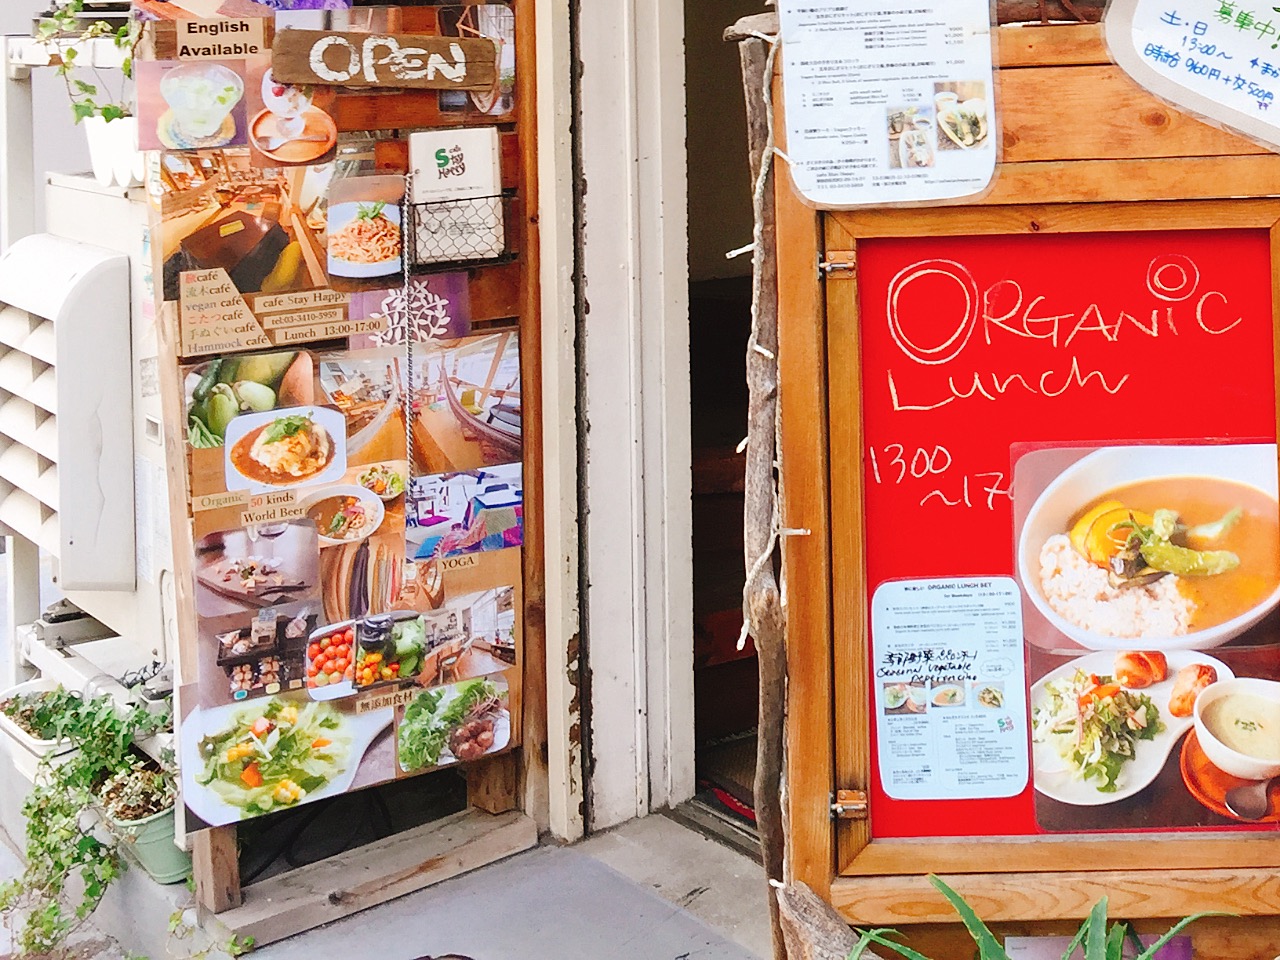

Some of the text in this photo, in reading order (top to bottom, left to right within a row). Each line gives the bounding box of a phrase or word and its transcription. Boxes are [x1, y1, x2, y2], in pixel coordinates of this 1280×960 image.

[187, 21, 249, 36] English
[179, 43, 258, 56] Available
[309, 35, 467, 83] OPEN
[220, 296, 241, 307] café
[263, 292, 347, 308] cafe Stay Happy
[284, 321, 381, 340] Lunch 13:00-17:00
[188, 335, 268, 353] Hammock café
[887, 355, 1130, 412] Lunch
[201, 493, 245, 507] Organic
[250, 492, 294, 507] 50 kinds
[243, 508, 304, 523] World Beer
[442, 556, 474, 570] YOGA
[927, 583, 956, 591] ORGANIC
